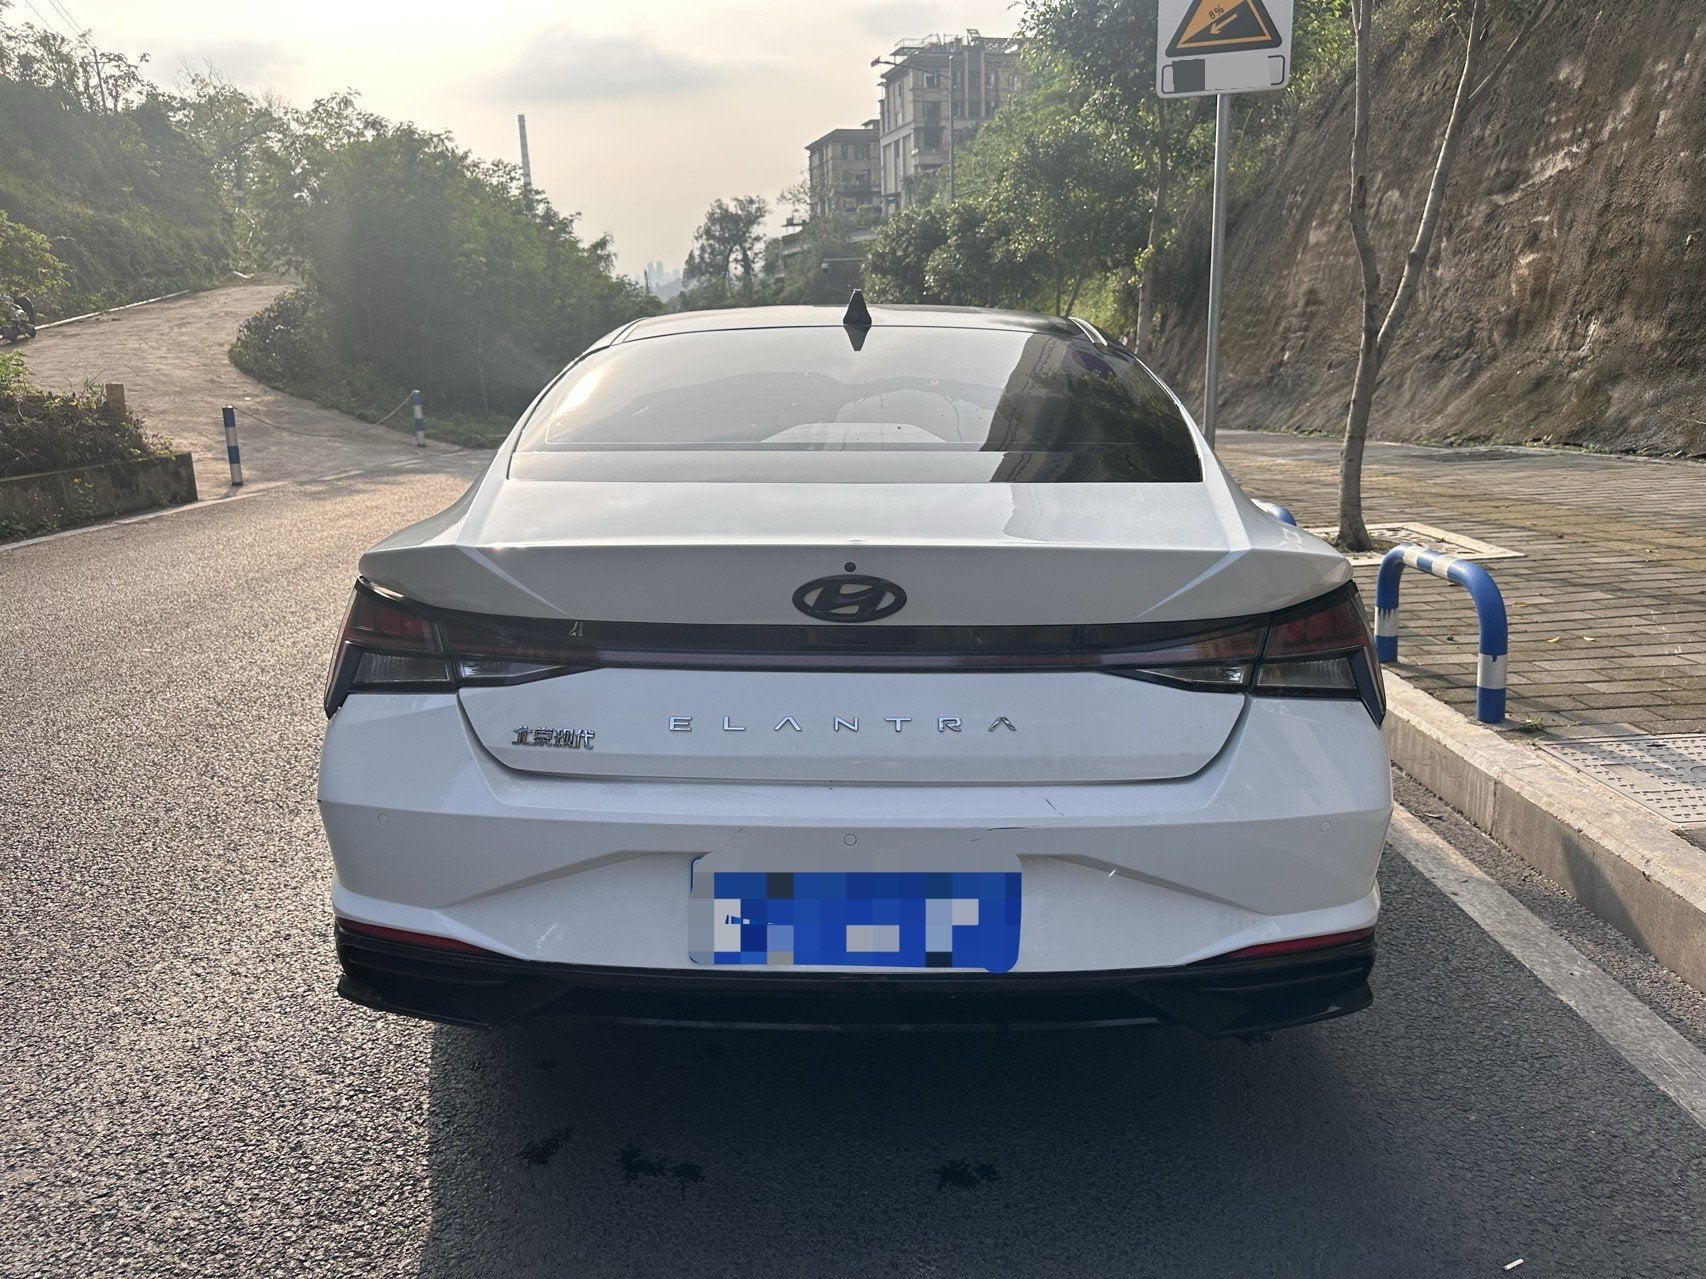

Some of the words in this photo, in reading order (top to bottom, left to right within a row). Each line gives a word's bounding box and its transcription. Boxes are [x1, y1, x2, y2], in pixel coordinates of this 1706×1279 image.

[1208, 5, 1224, 20] 8%
[668, 715, 1017, 733] ELANTRA
[511, 725, 595, 750] 北京现代
